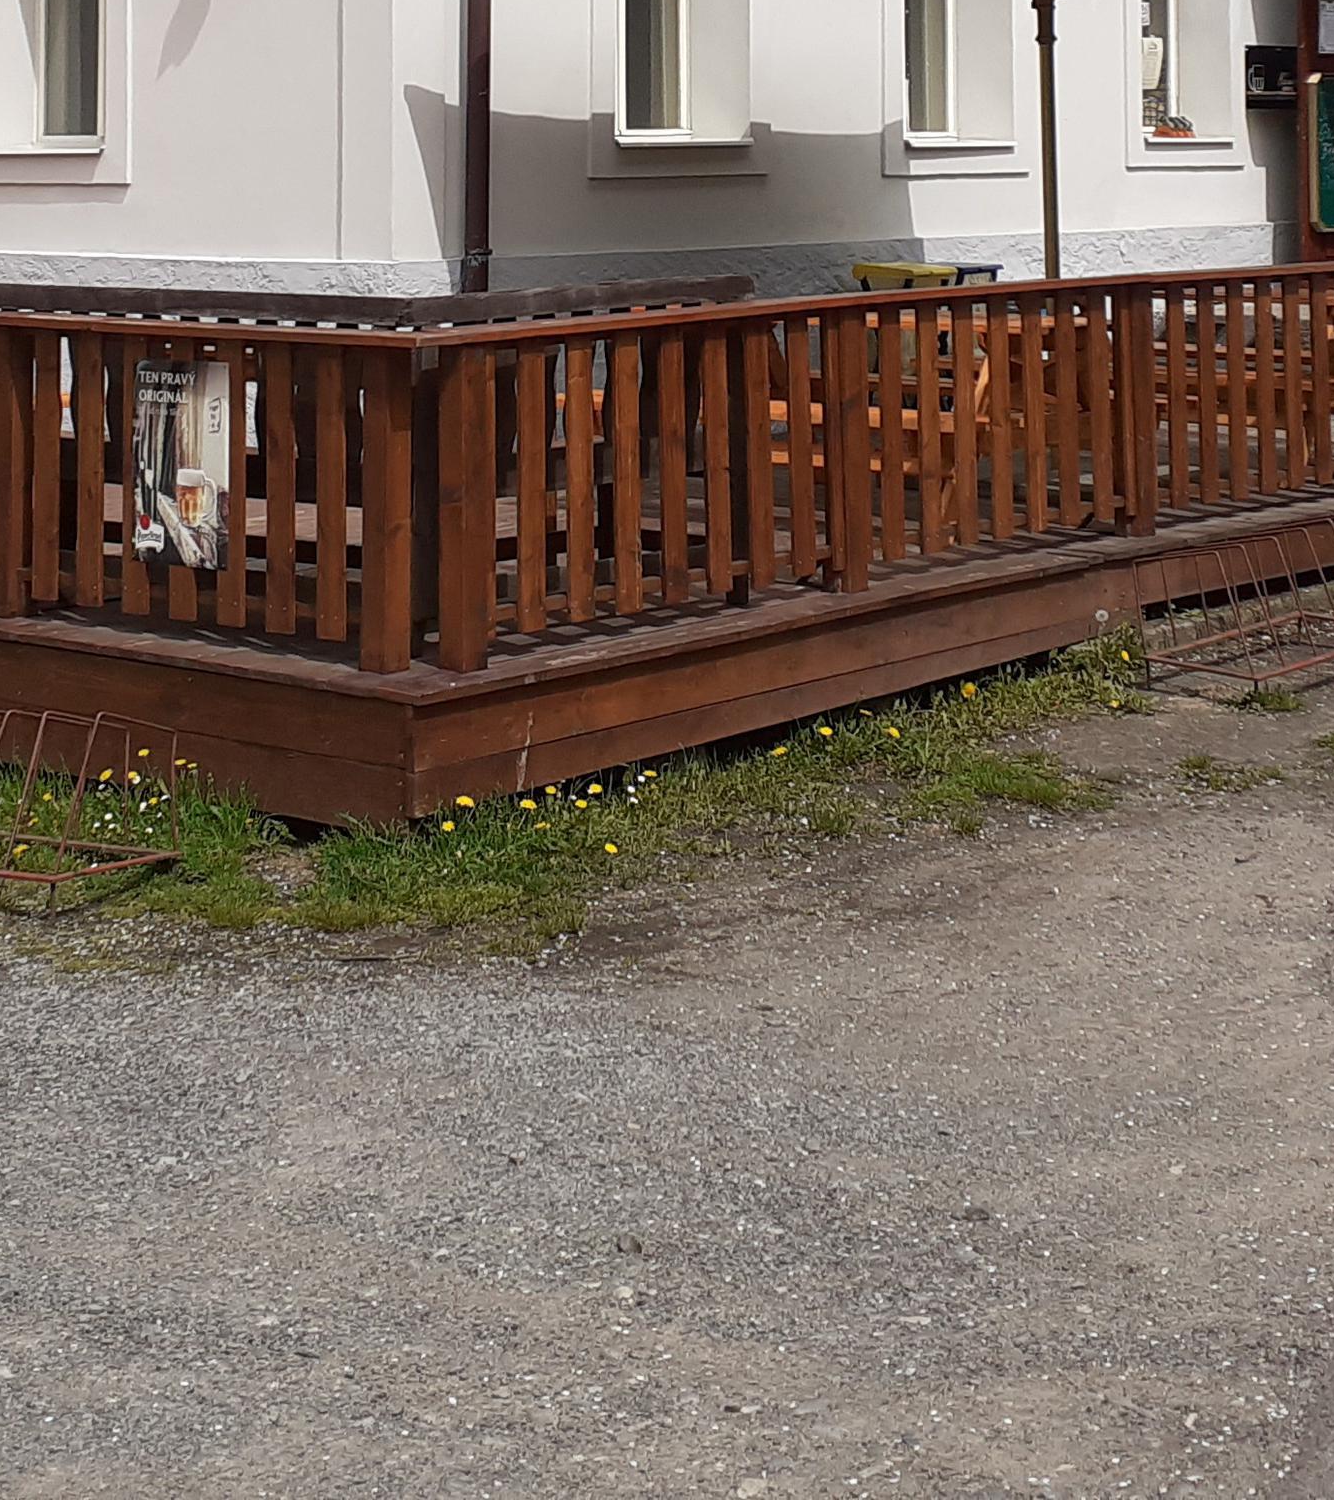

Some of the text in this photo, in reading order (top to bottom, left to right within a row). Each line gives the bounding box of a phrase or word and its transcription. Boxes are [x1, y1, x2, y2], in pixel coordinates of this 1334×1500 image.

[139, 371, 196, 385] TEN PRAVÝ
[138, 389, 189, 403] ORIGINÁL
